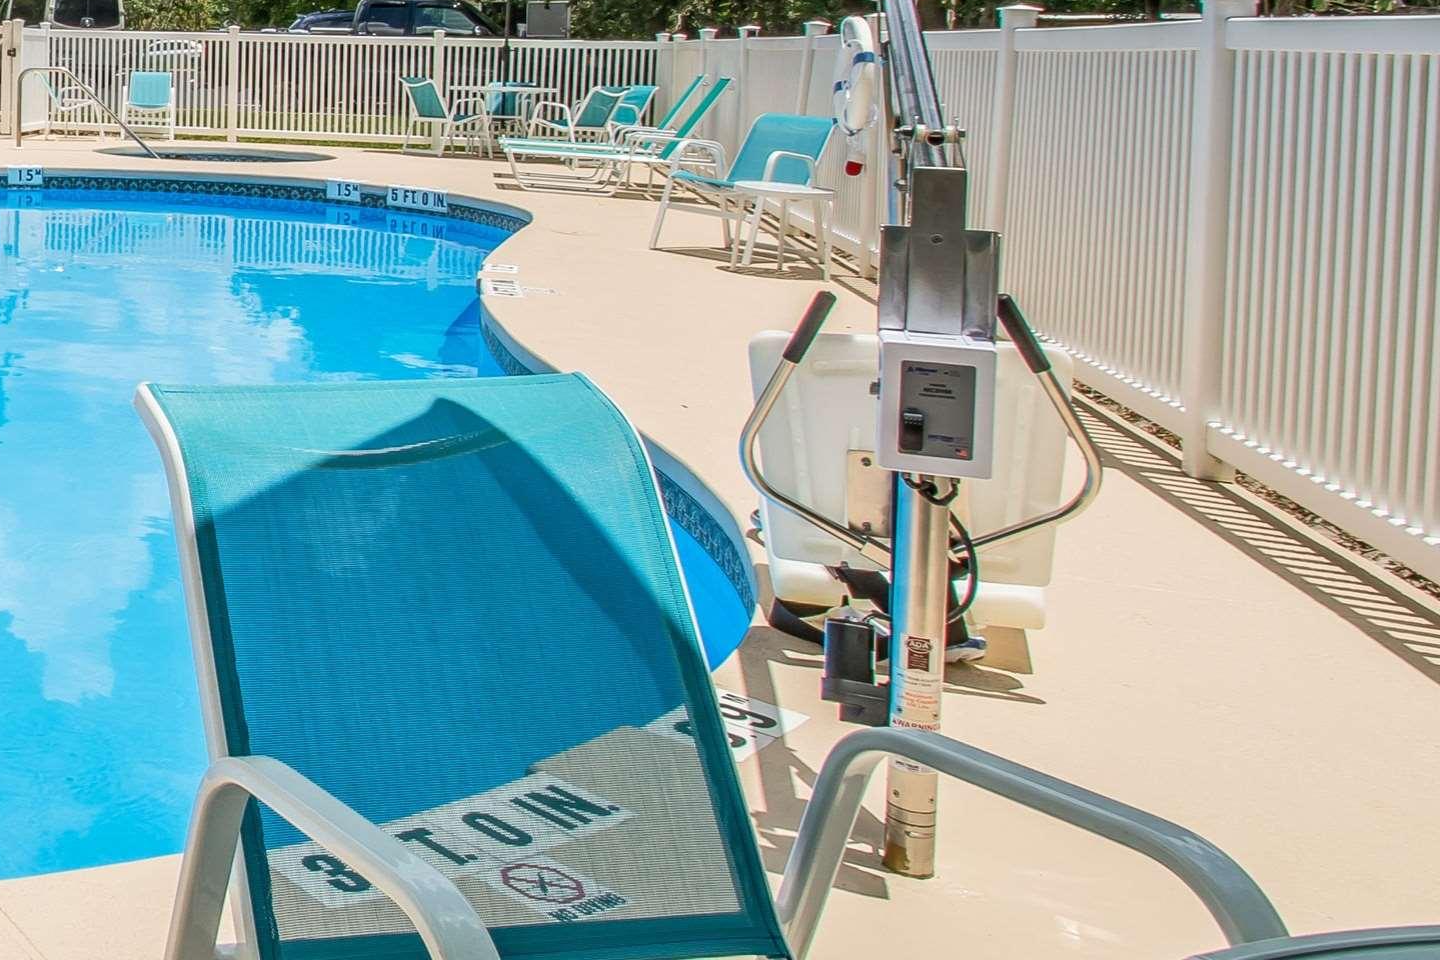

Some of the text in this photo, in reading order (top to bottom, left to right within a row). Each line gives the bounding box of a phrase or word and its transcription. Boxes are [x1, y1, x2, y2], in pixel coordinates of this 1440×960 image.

[391, 189, 399, 202] 5
[301, 854, 371, 893] 3
[511, 784, 622, 832] IN.
[571, 892, 627, 916] DIVING
